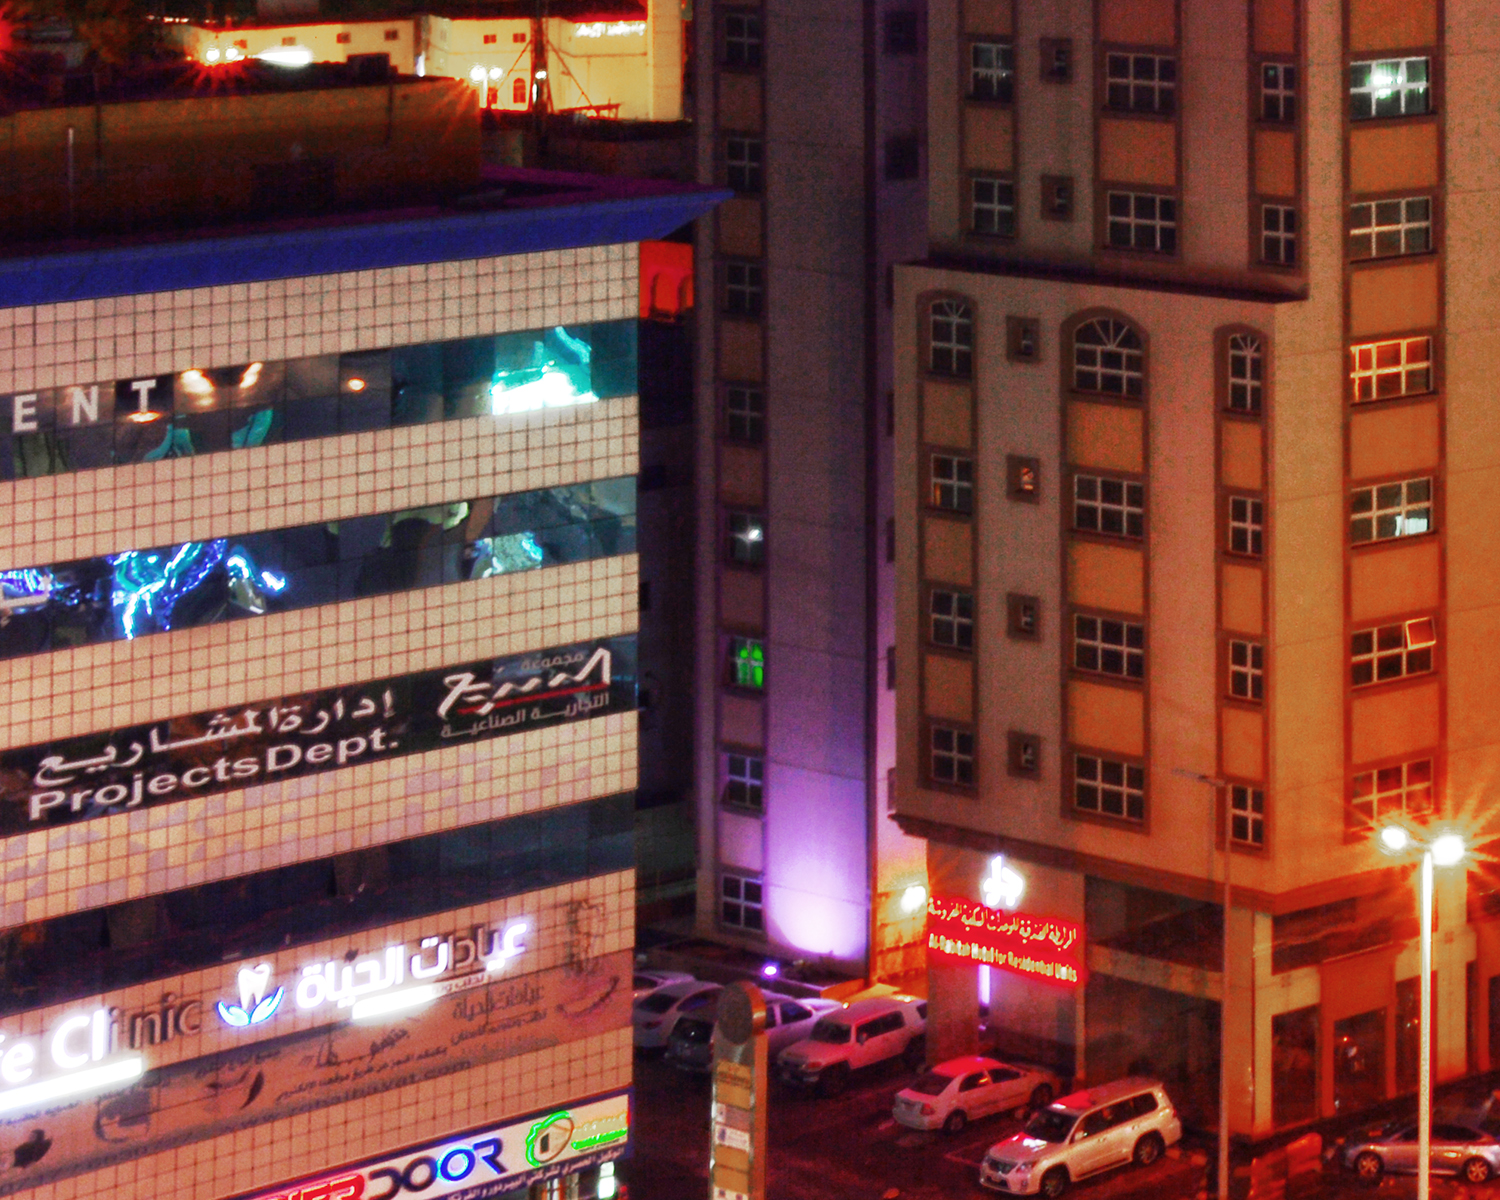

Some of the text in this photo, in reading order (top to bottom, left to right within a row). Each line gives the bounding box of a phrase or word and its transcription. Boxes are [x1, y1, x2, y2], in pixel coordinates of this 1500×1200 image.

[28, 726, 400, 821] Projects Dept.
[295, 922, 528, 1009] عيادات الحياة
[51, 992, 202, 1069] Clinic
